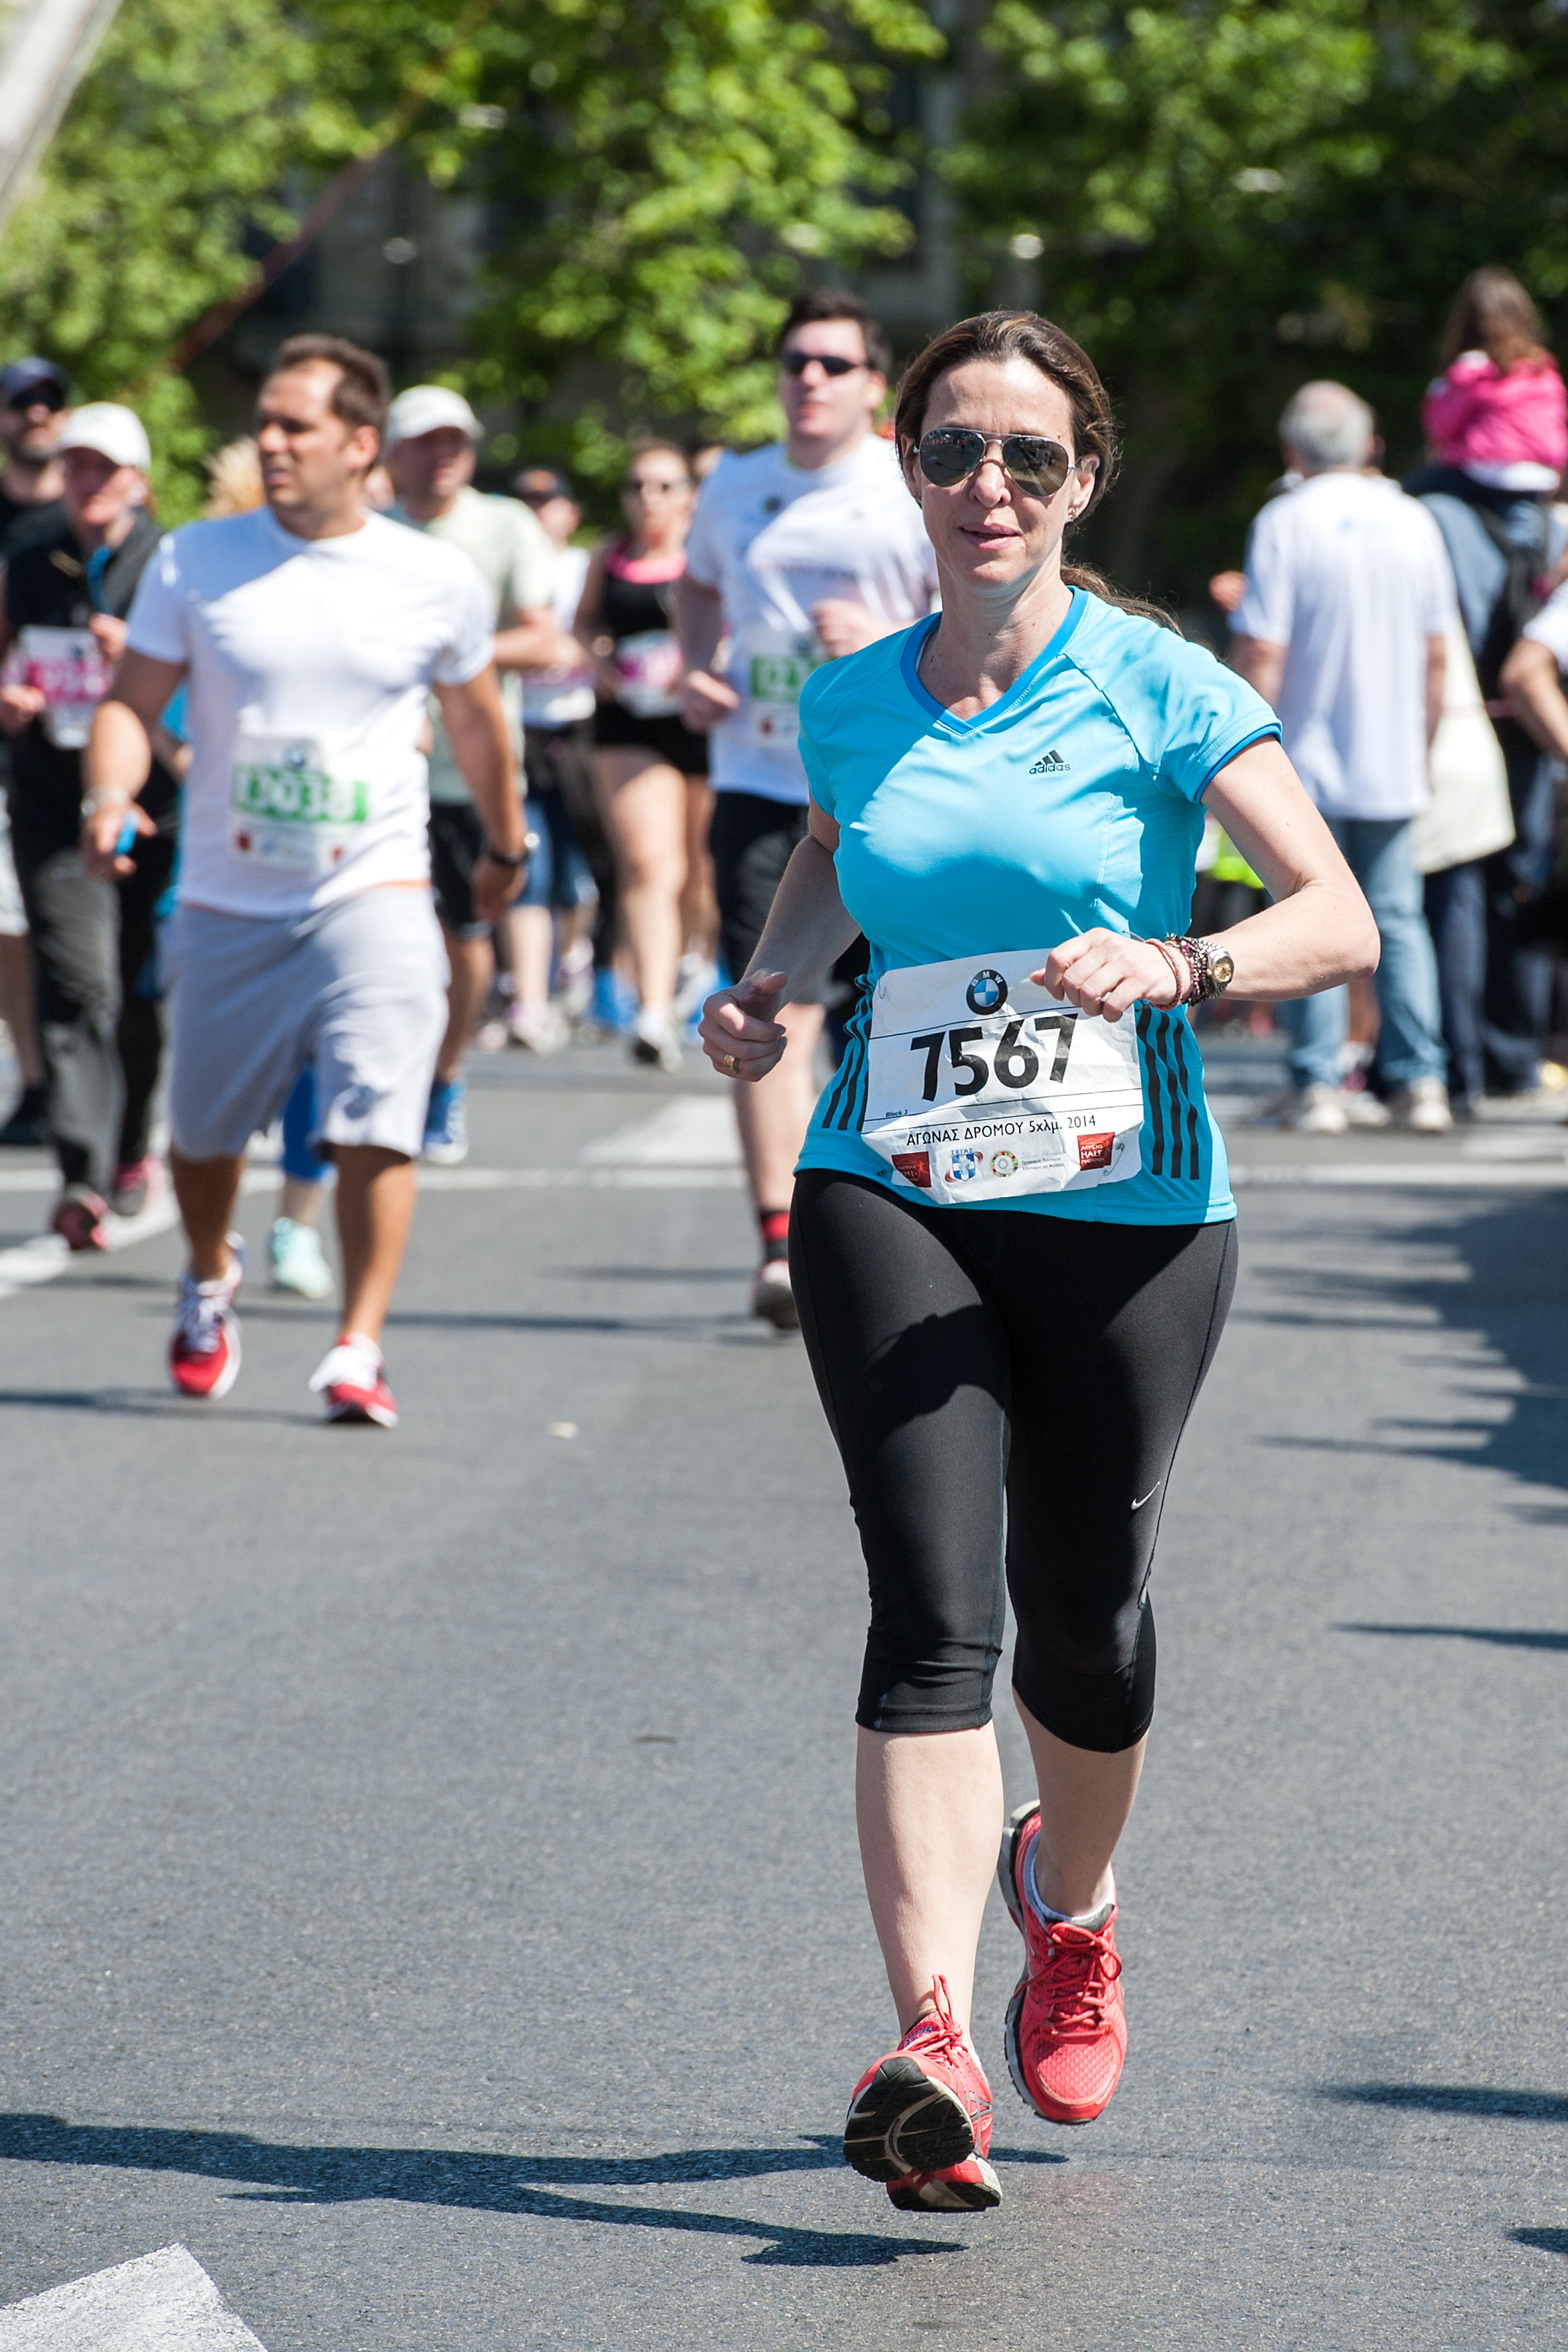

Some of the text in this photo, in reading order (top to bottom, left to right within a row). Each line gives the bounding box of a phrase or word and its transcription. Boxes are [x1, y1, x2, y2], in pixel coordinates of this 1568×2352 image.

[1029, 763, 1071, 775] adidas
[971, 970, 1004, 987] BMW
[910, 1014, 1078, 1102] 7567
[907, 1129, 960, 1146] ΑΓΩΝΑΣ
[964, 1121, 1024, 1140] ΔΡΟΜΟΥ
[1067, 1115, 1096, 1129] 2014
[1081, 1150, 1103, 1159] HALF
